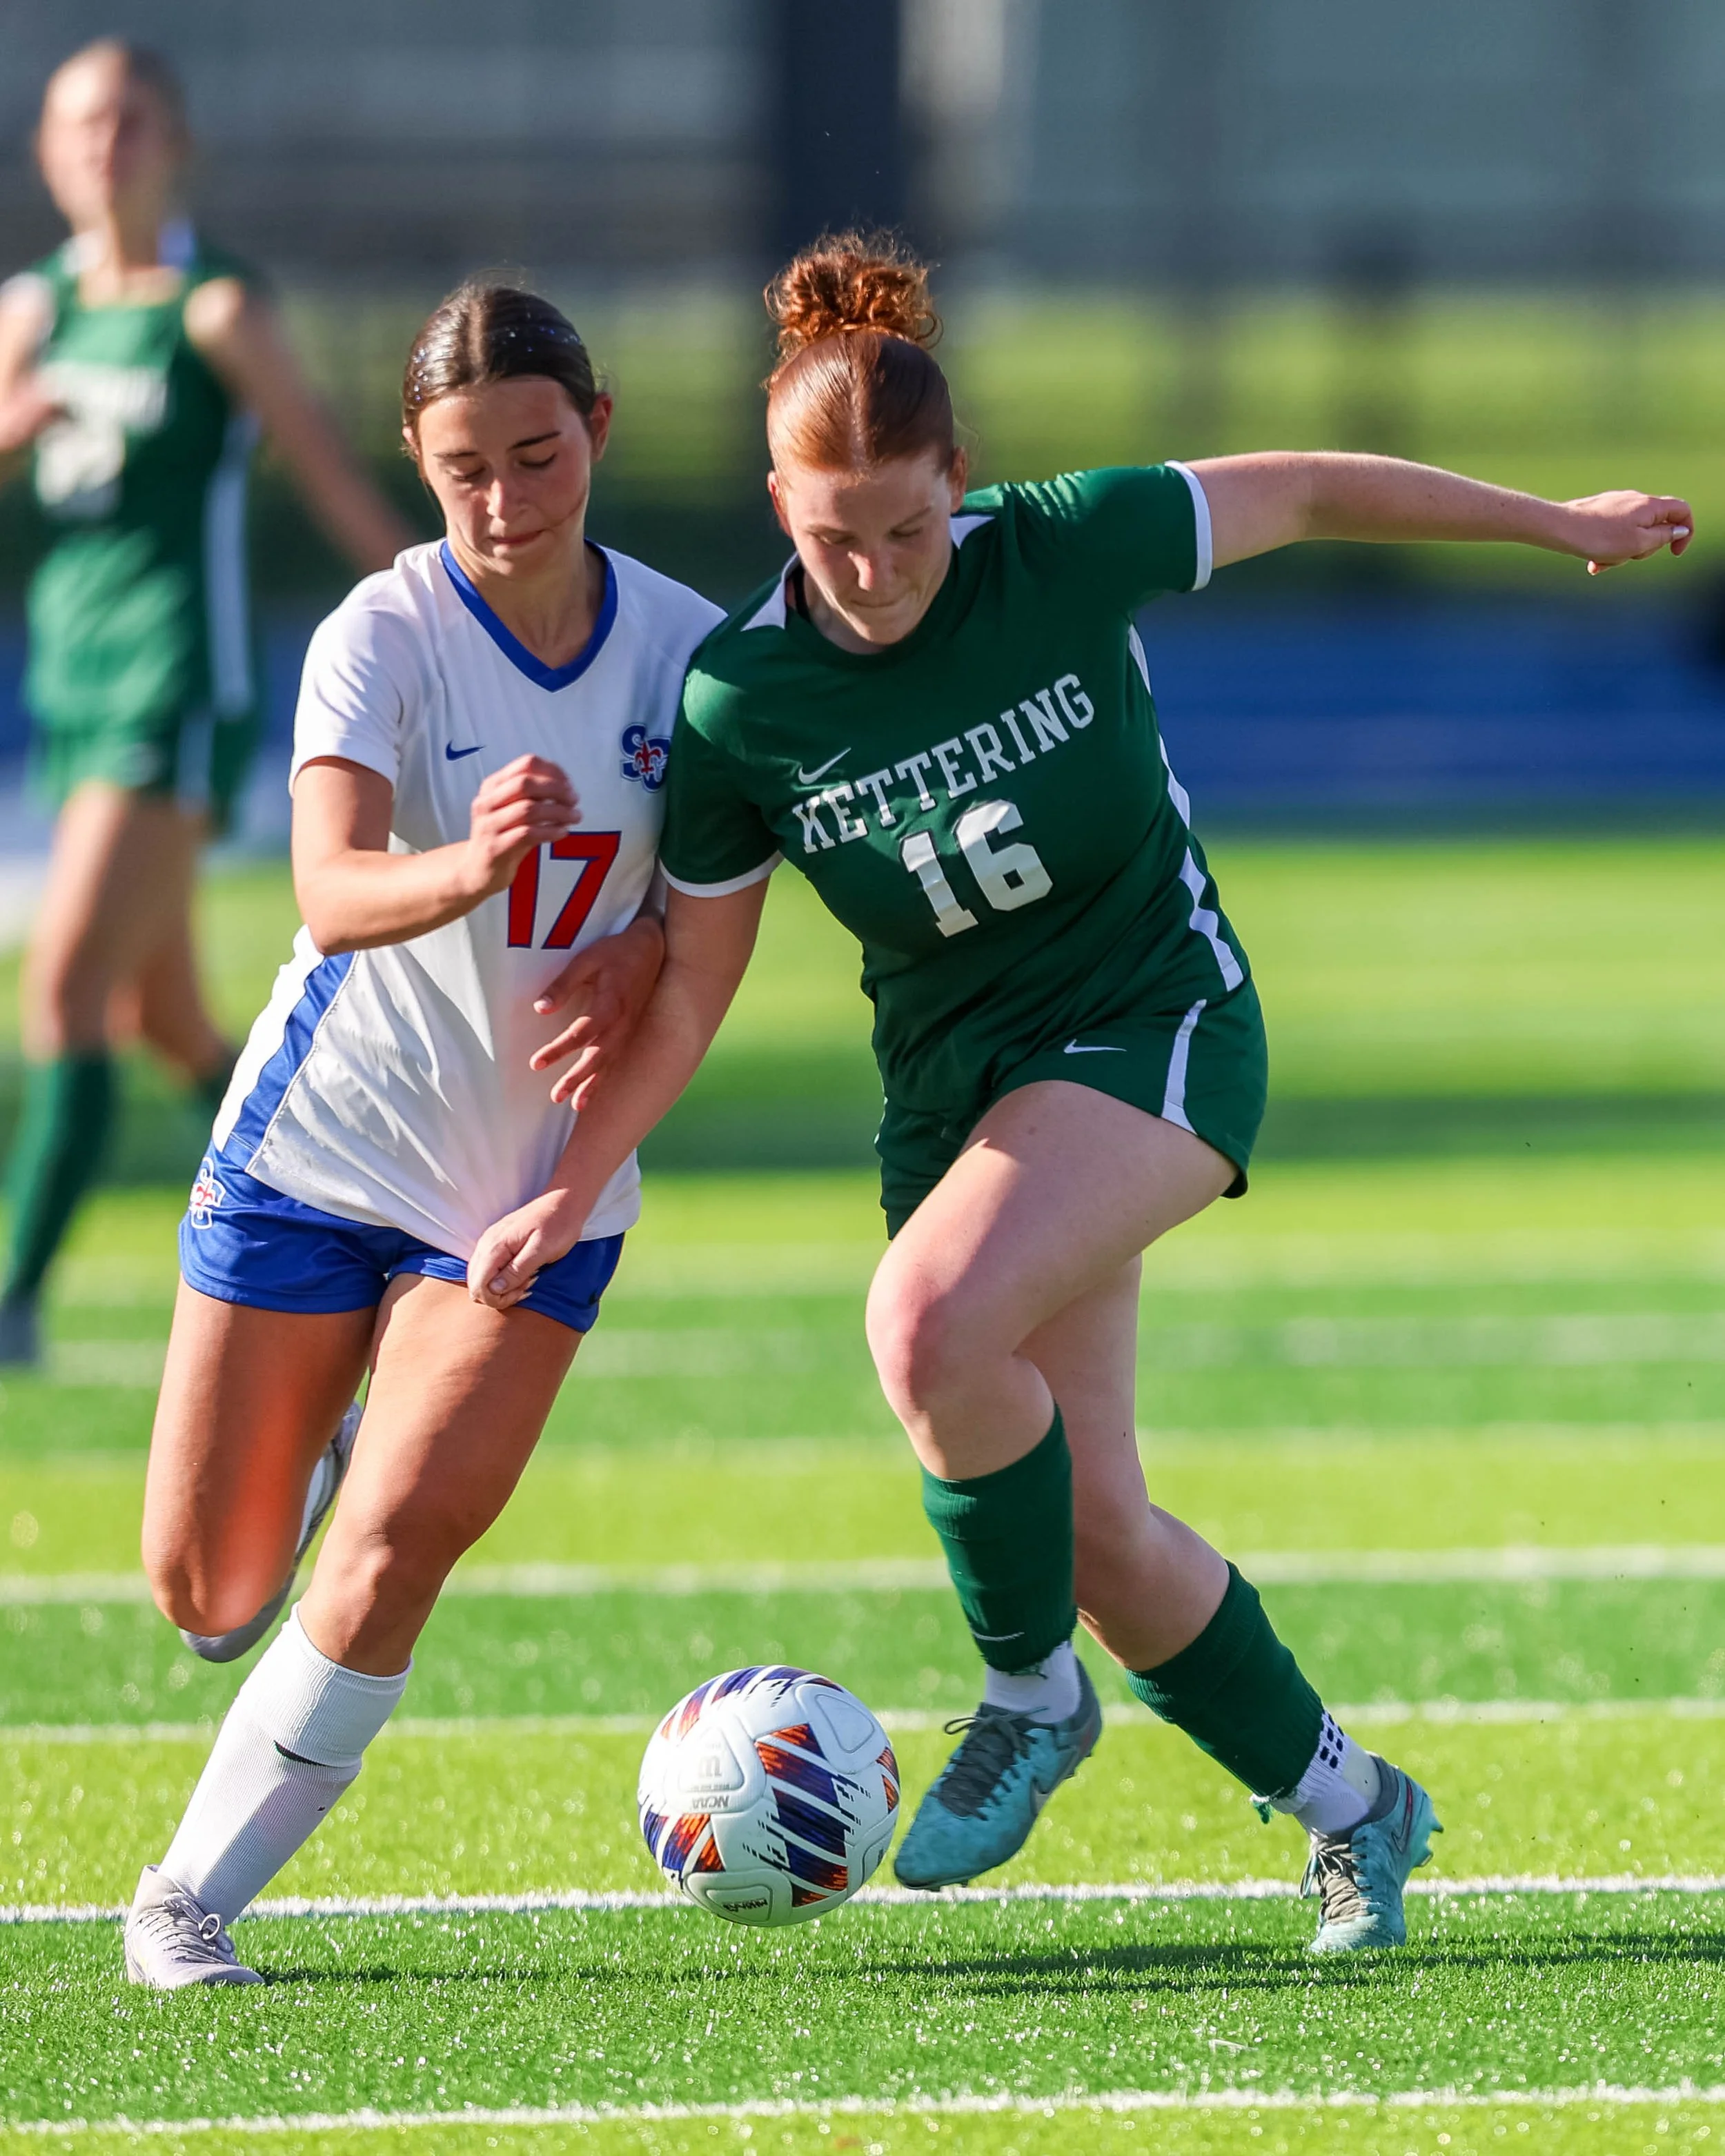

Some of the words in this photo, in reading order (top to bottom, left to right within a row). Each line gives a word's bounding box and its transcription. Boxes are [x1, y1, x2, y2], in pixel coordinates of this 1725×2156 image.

[791, 673, 1095, 853] KETTERING
[507, 831, 622, 949] 17
[900, 799, 1054, 938] 16
